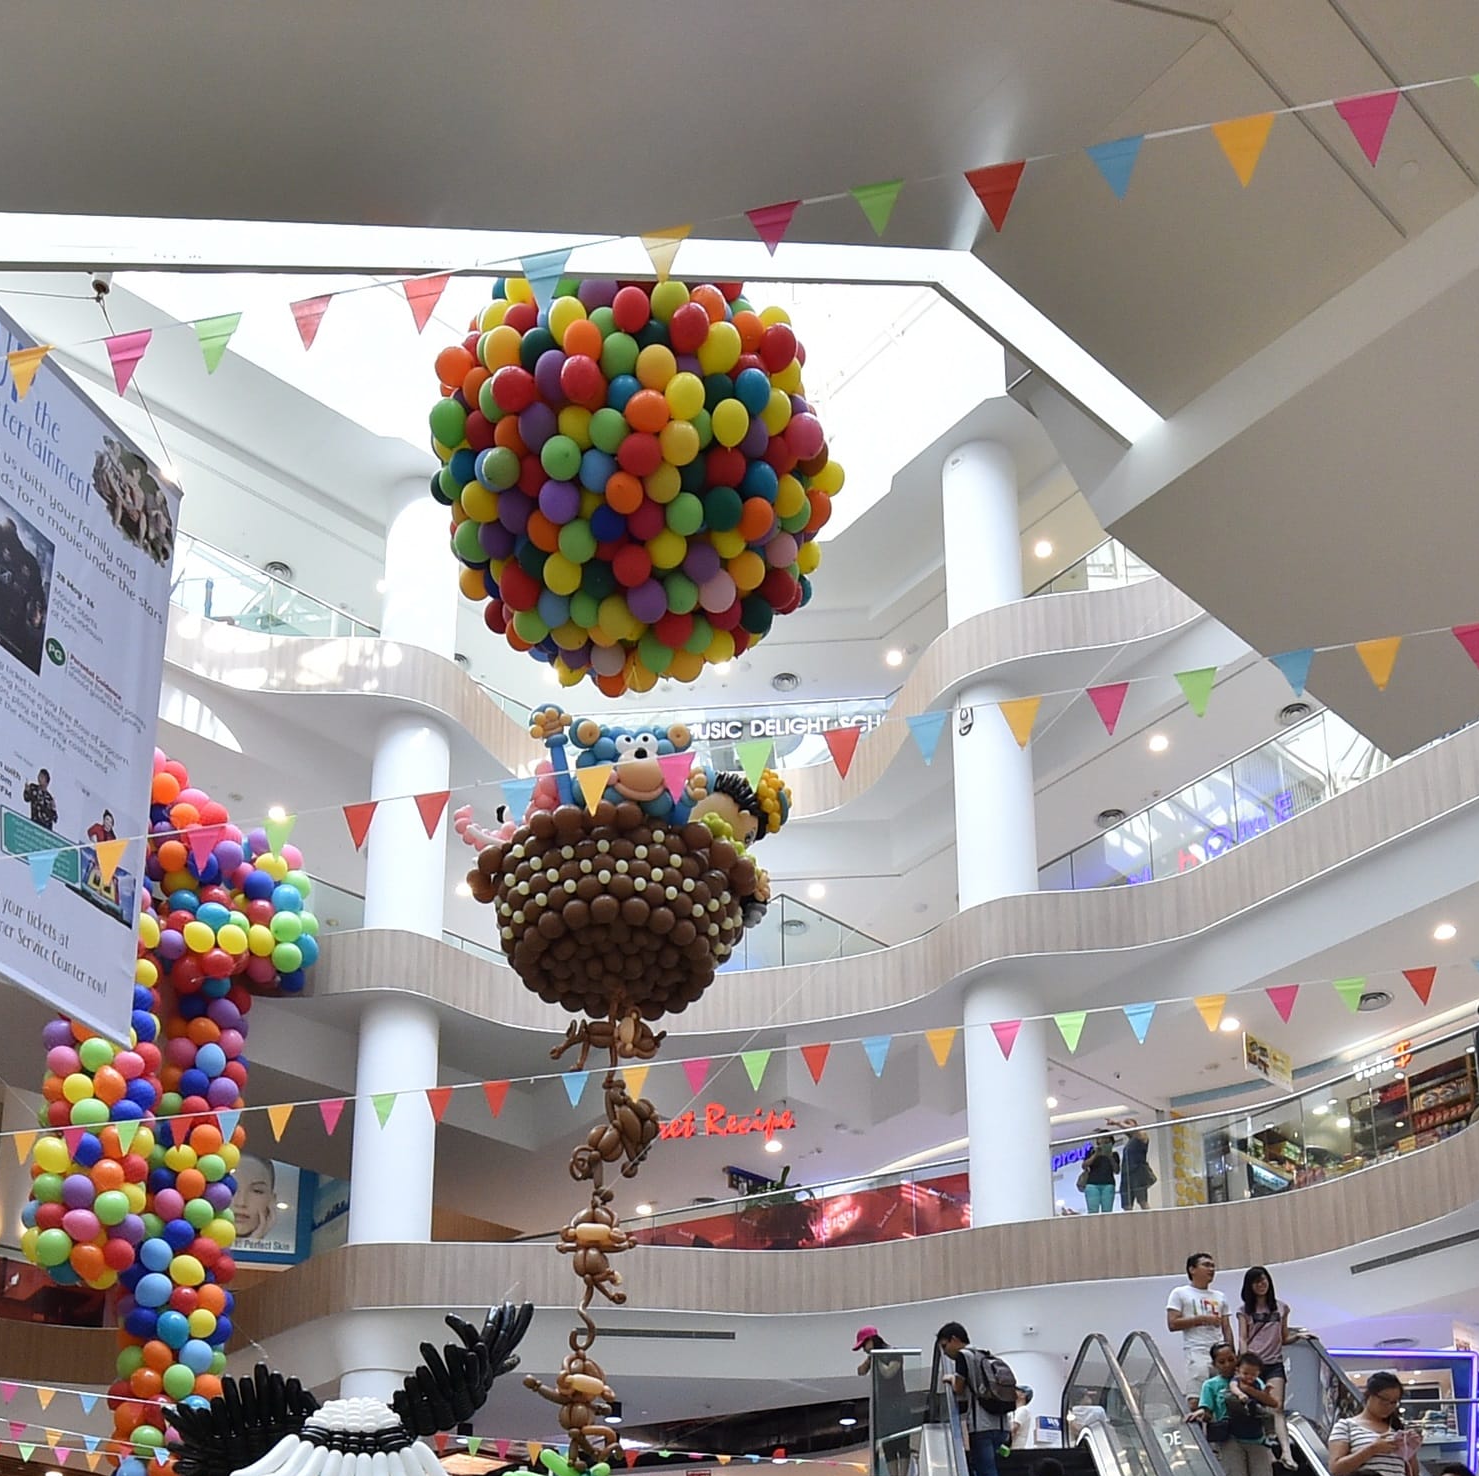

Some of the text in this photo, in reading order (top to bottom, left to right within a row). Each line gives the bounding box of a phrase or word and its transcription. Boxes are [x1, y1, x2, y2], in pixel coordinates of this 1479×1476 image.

[34, 401, 61, 443] the
[4, 450, 17, 471] us
[20, 469, 47, 498] with
[50, 495, 76, 522] your
[78, 518, 114, 563] family
[116, 558, 137, 581] and
[17, 488, 35, 507] for
[37, 506, 45, 517] a
[48, 514, 82, 552] movie
[84, 549, 117, 582] under
[118, 577, 136, 602] the
[138, 593, 163, 625] stars
[48, 643, 63, 662] PG
[6, 663, 27, 687] ticket
[28, 682, 37, 693] to
[14, 680, 35, 702] home
[4, 697, 17, 715] the
[750, 716, 831, 737] DELIGHT
[4, 765, 21, 781] with
[2, 896, 24, 918] your
[26, 909, 57, 942] tickets
[58, 933, 70, 949] at
[17, 927, 49, 961] Service
[51, 950, 86, 983] Counter
[88, 974, 107, 997] now!
[703, 1102, 796, 1142] Recipe
